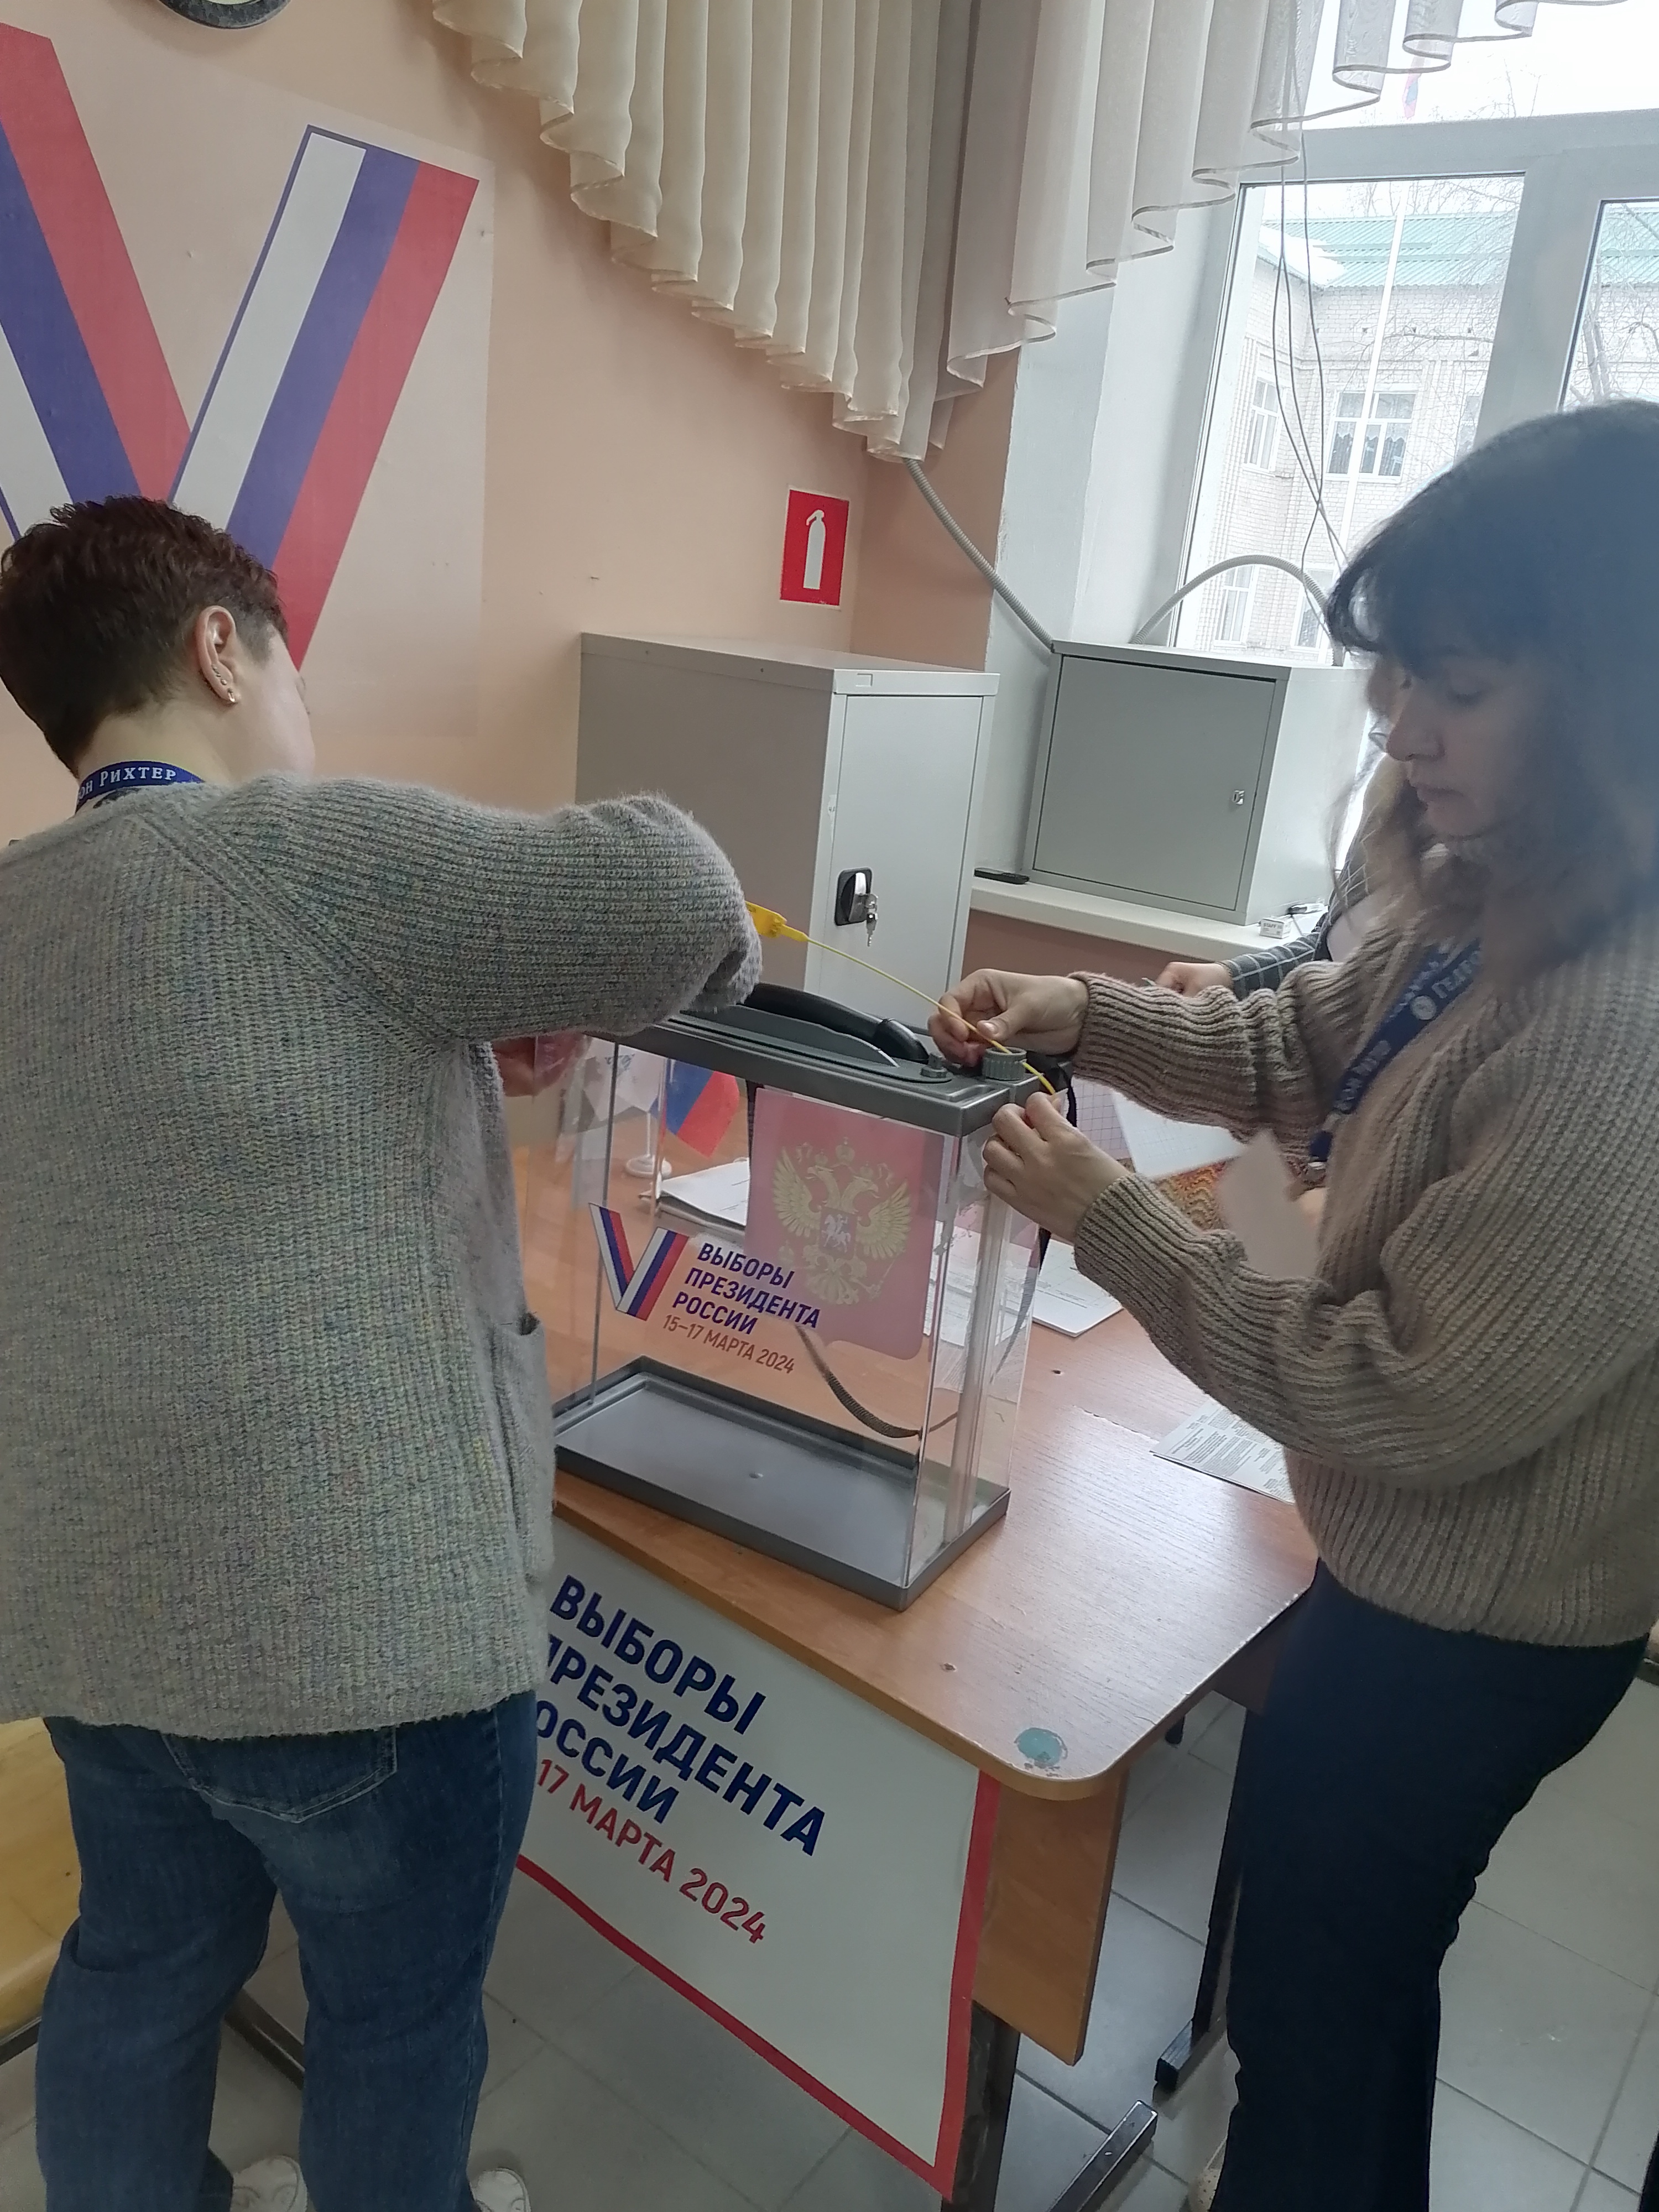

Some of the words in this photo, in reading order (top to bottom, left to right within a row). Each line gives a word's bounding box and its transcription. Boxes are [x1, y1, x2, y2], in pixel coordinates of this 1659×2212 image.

[100, 767, 176, 787] РИХТЕР
[697, 1242, 795, 1289] ВЫБОРЫ
[672, 1291, 758, 1335] РОССИИ
[685, 1267, 821, 1328] ПРЕЗИДЕНТА
[704, 1329, 754, 1360] МАРТА
[756, 1349, 795, 1374] 2024
[550, 1575, 766, 1735] ВЫБОРЫ
[537, 1700, 679, 1824] ОССИИ
[568, 1783, 676, 1882] МАРТА
[679, 1867, 766, 1944] 2024
